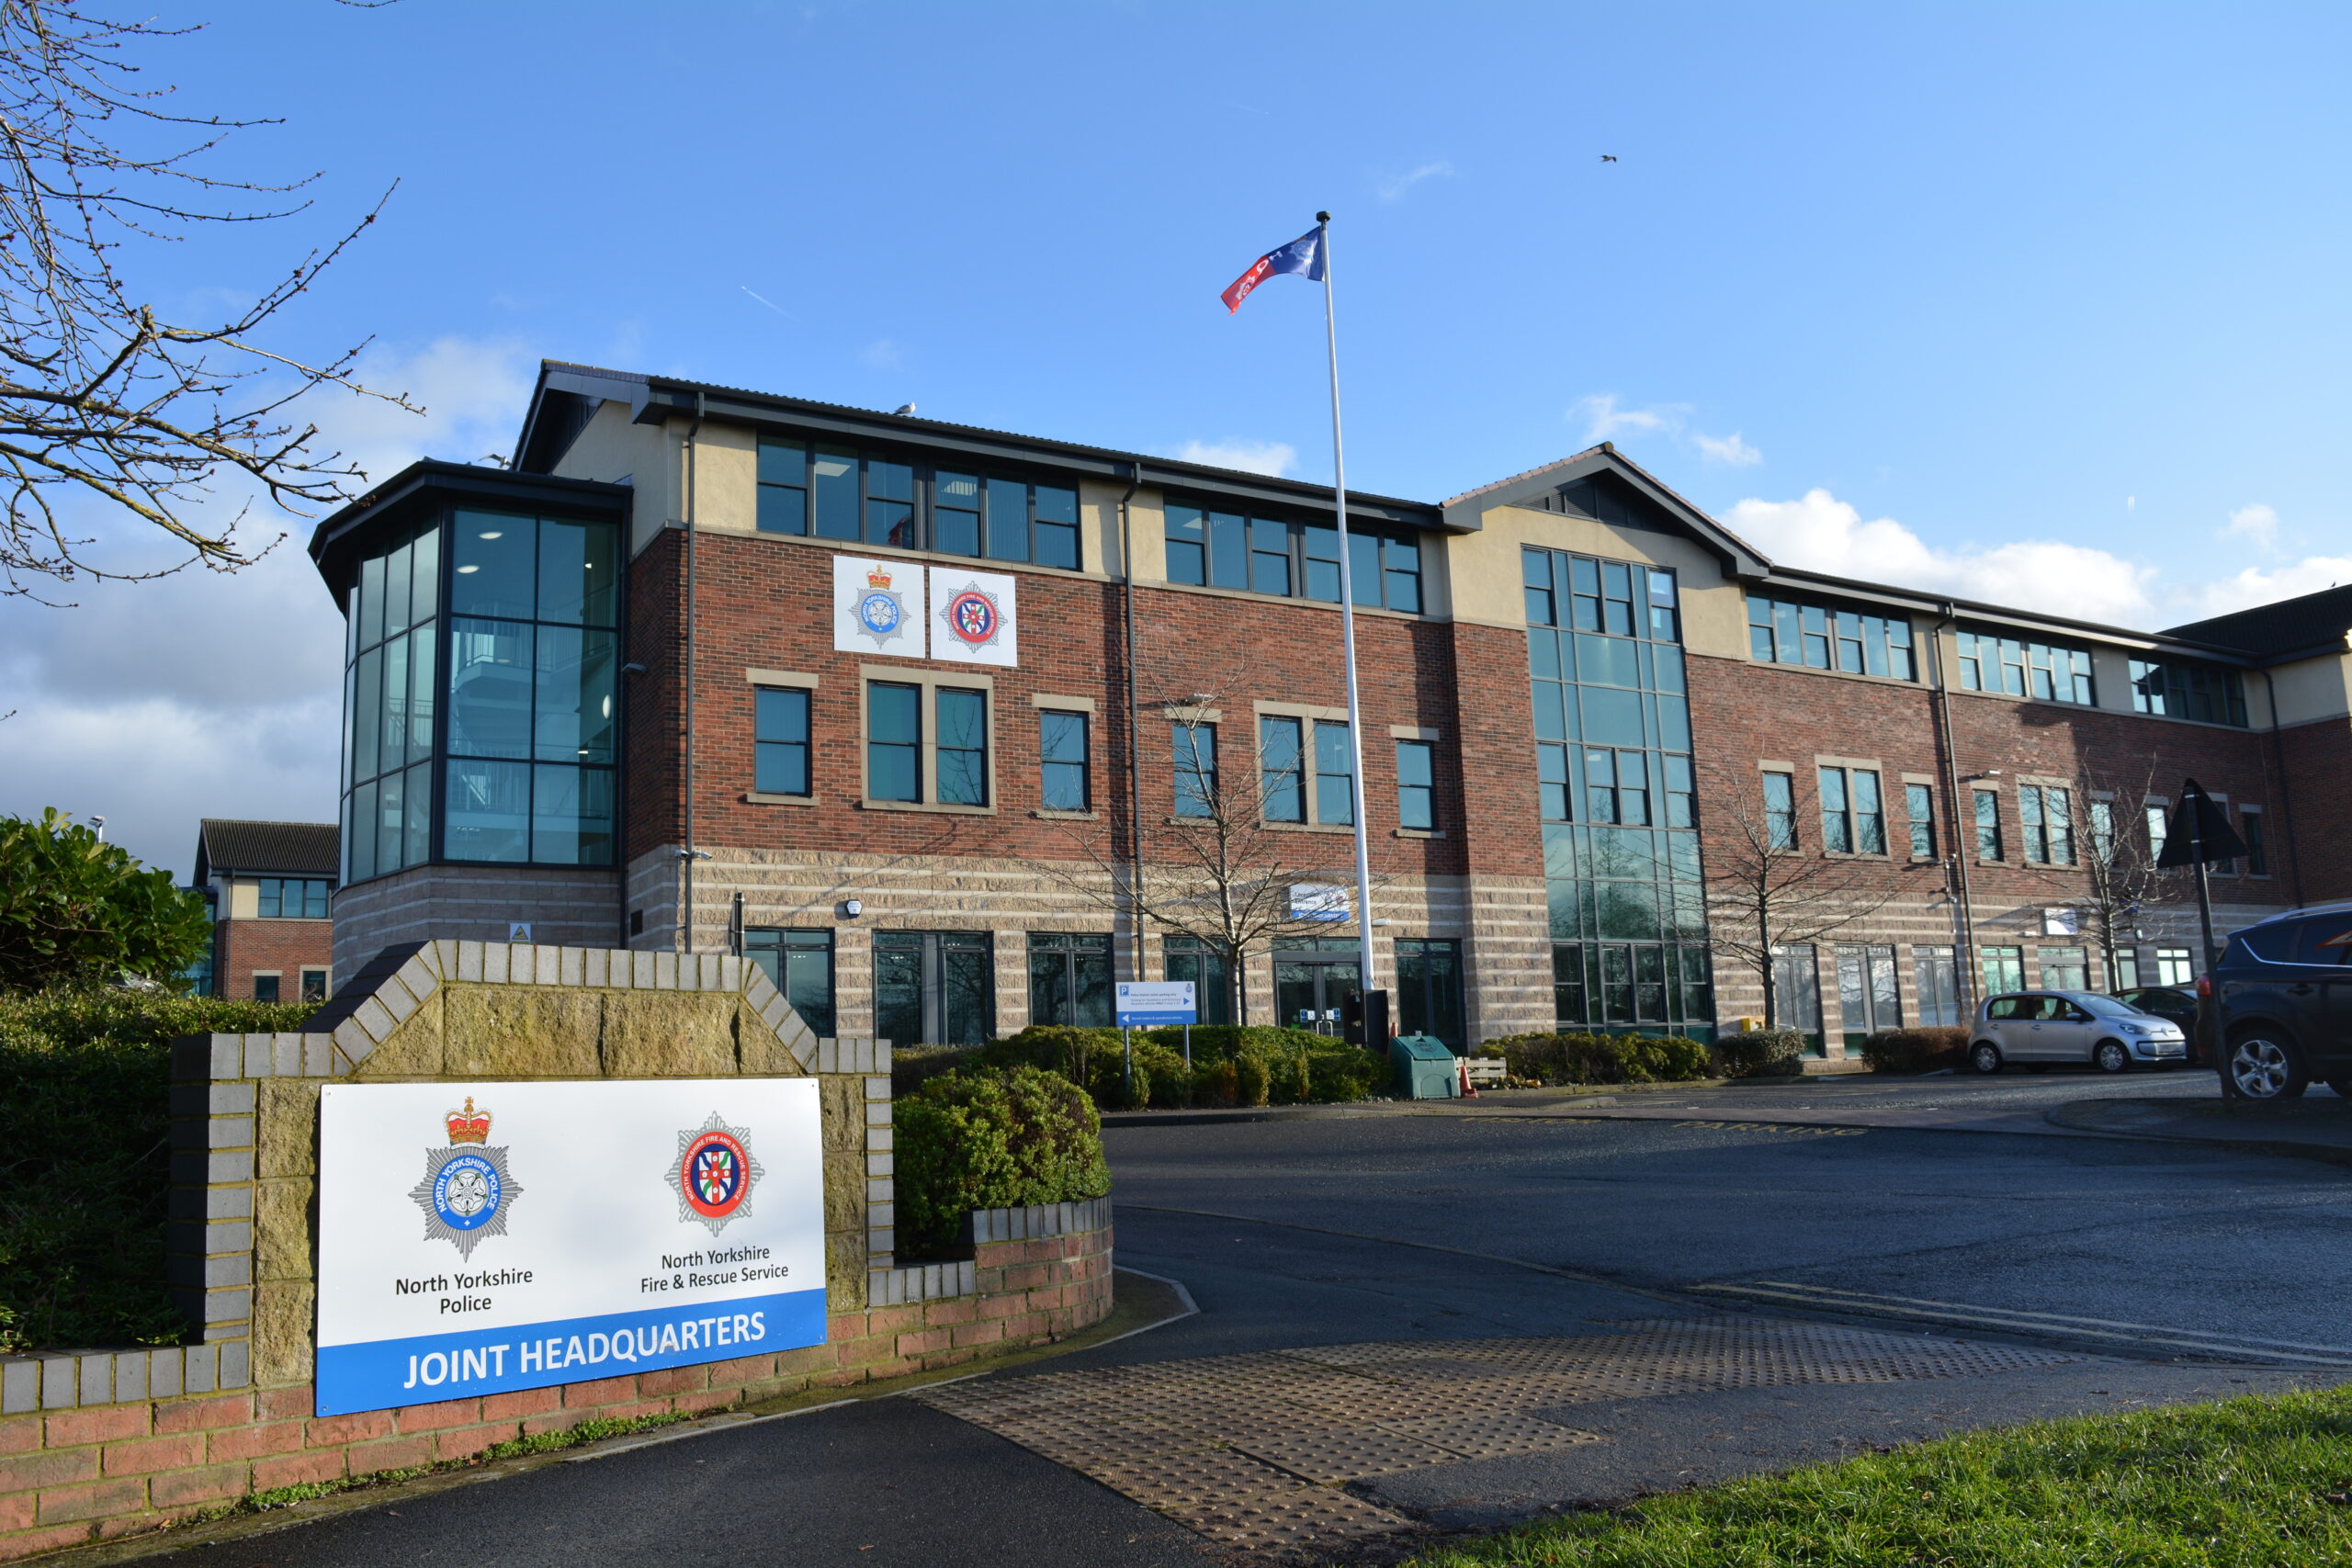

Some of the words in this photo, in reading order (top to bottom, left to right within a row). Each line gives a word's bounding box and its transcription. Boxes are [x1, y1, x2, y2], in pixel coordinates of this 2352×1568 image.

[719, 1136, 731, 1145] AND
[1672, 1121, 1869, 1136] PARKING
[684, 1139, 705, 1174] YORKSHIRE
[731, 1144, 746, 1169] RESCUE
[435, 1178, 447, 1213] NORTH
[442, 1157, 491, 1177] YORKSHIRE
[487, 1174, 498, 1210] POLICE
[684, 1177, 695, 1201] NORTH
[734, 1171, 746, 1201] SERVICE
[662, 1251, 703, 1269] North
[707, 1246, 770, 1264] Yorkshire
[396, 1274, 448, 1295] North
[454, 1268, 533, 1290] Yorkshire
[641, 1277, 668, 1293] Fire
[673, 1274, 684, 1290] &
[689, 1271, 738, 1288] Rescue
[741, 1264, 789, 1282] Service
[440, 1295, 492, 1314] Police
[403, 1345, 510, 1389] JOINT
[520, 1312, 765, 1373] HEADQUARTERS
